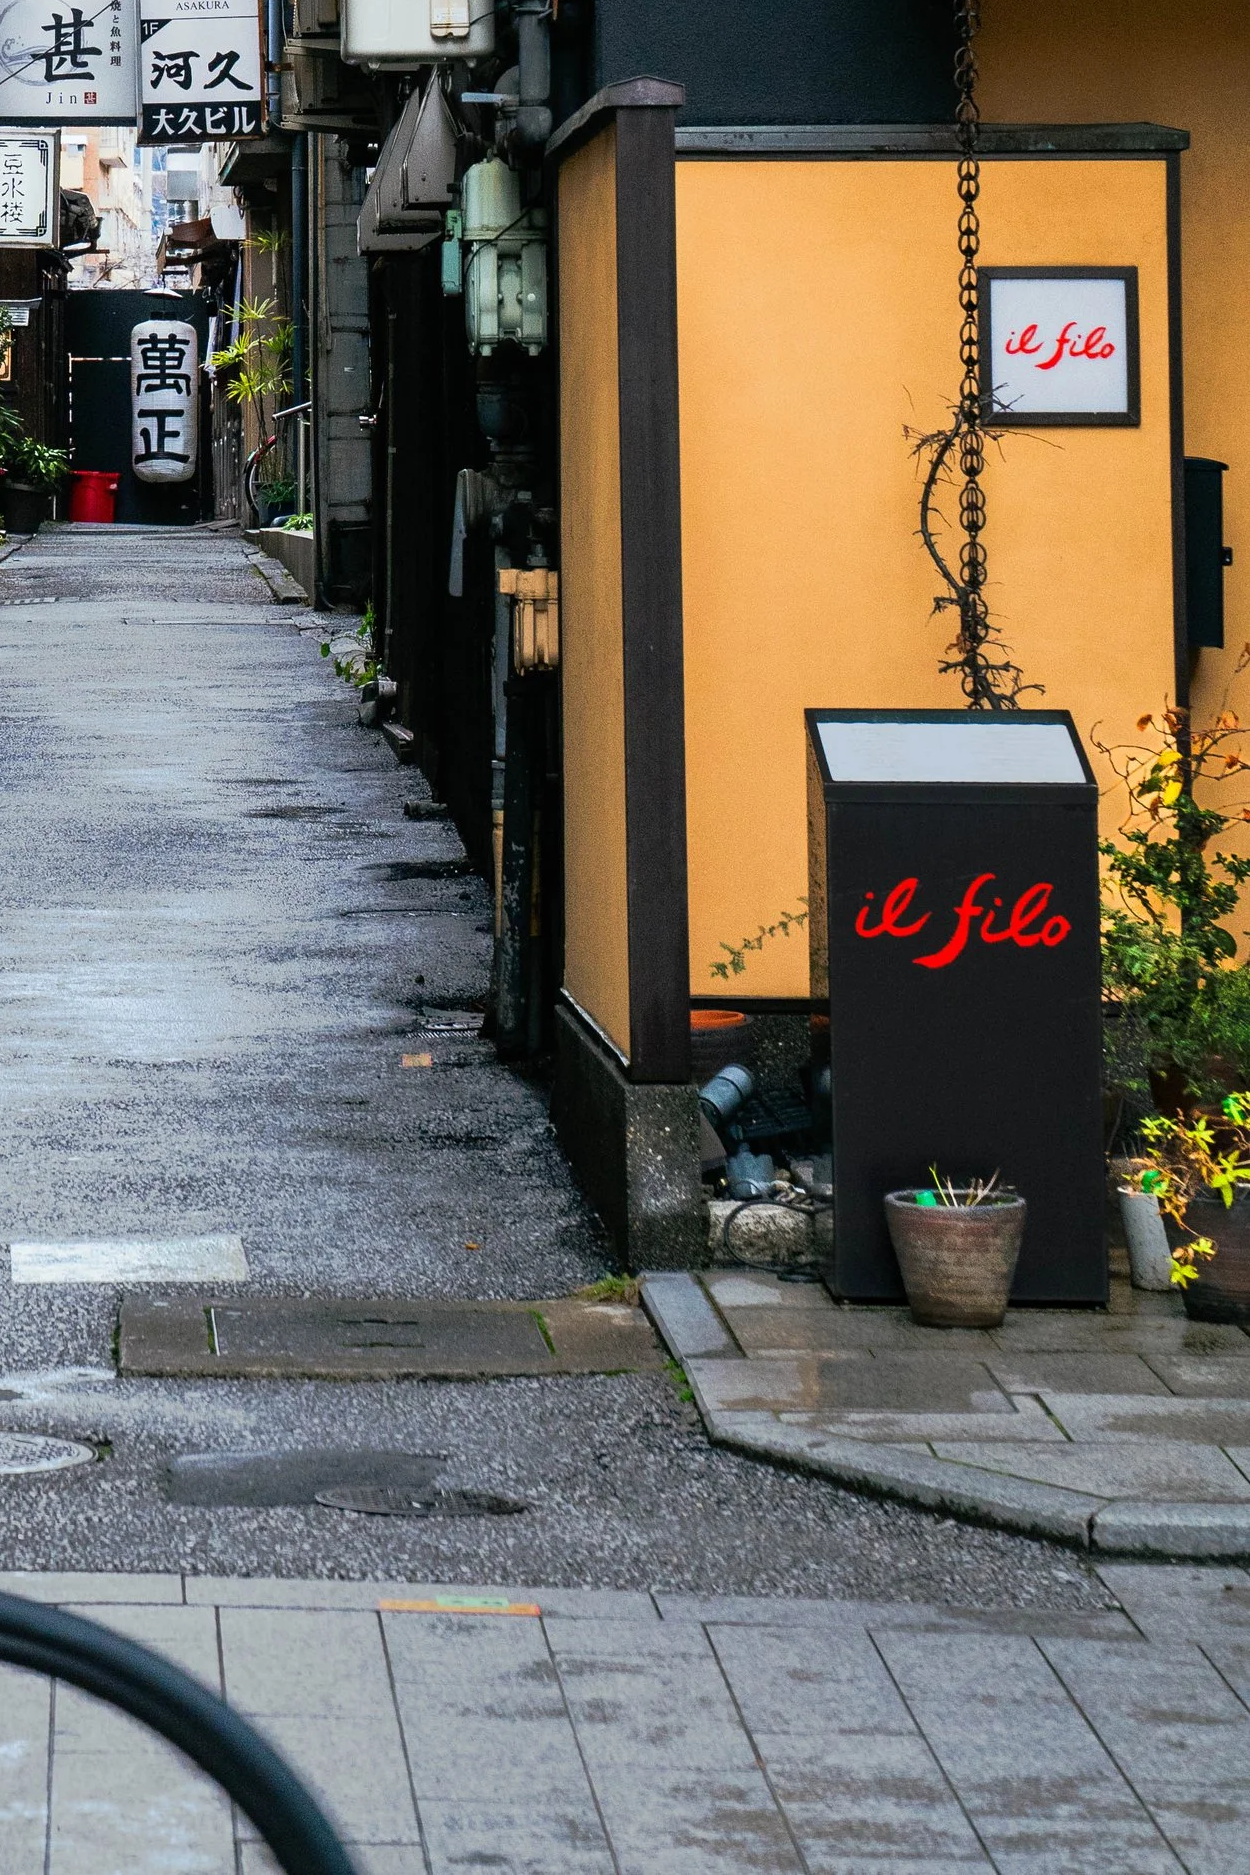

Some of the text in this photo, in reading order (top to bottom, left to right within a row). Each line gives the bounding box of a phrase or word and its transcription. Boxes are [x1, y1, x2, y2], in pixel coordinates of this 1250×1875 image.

[176, 1, 229, 11] ASAKURA
[30, 8, 103, 82] 甚
[142, 23, 158, 35] 1F
[150, 51, 254, 90] 河久
[46, 92, 77, 104] Jin
[151, 107, 255, 135] 大久ビル
[1, 154, 25, 223] 豆水楼
[1005, 321, 1115, 370] il filo
[134, 333, 191, 465] 萬正
[855, 873, 1072, 969] il filo
